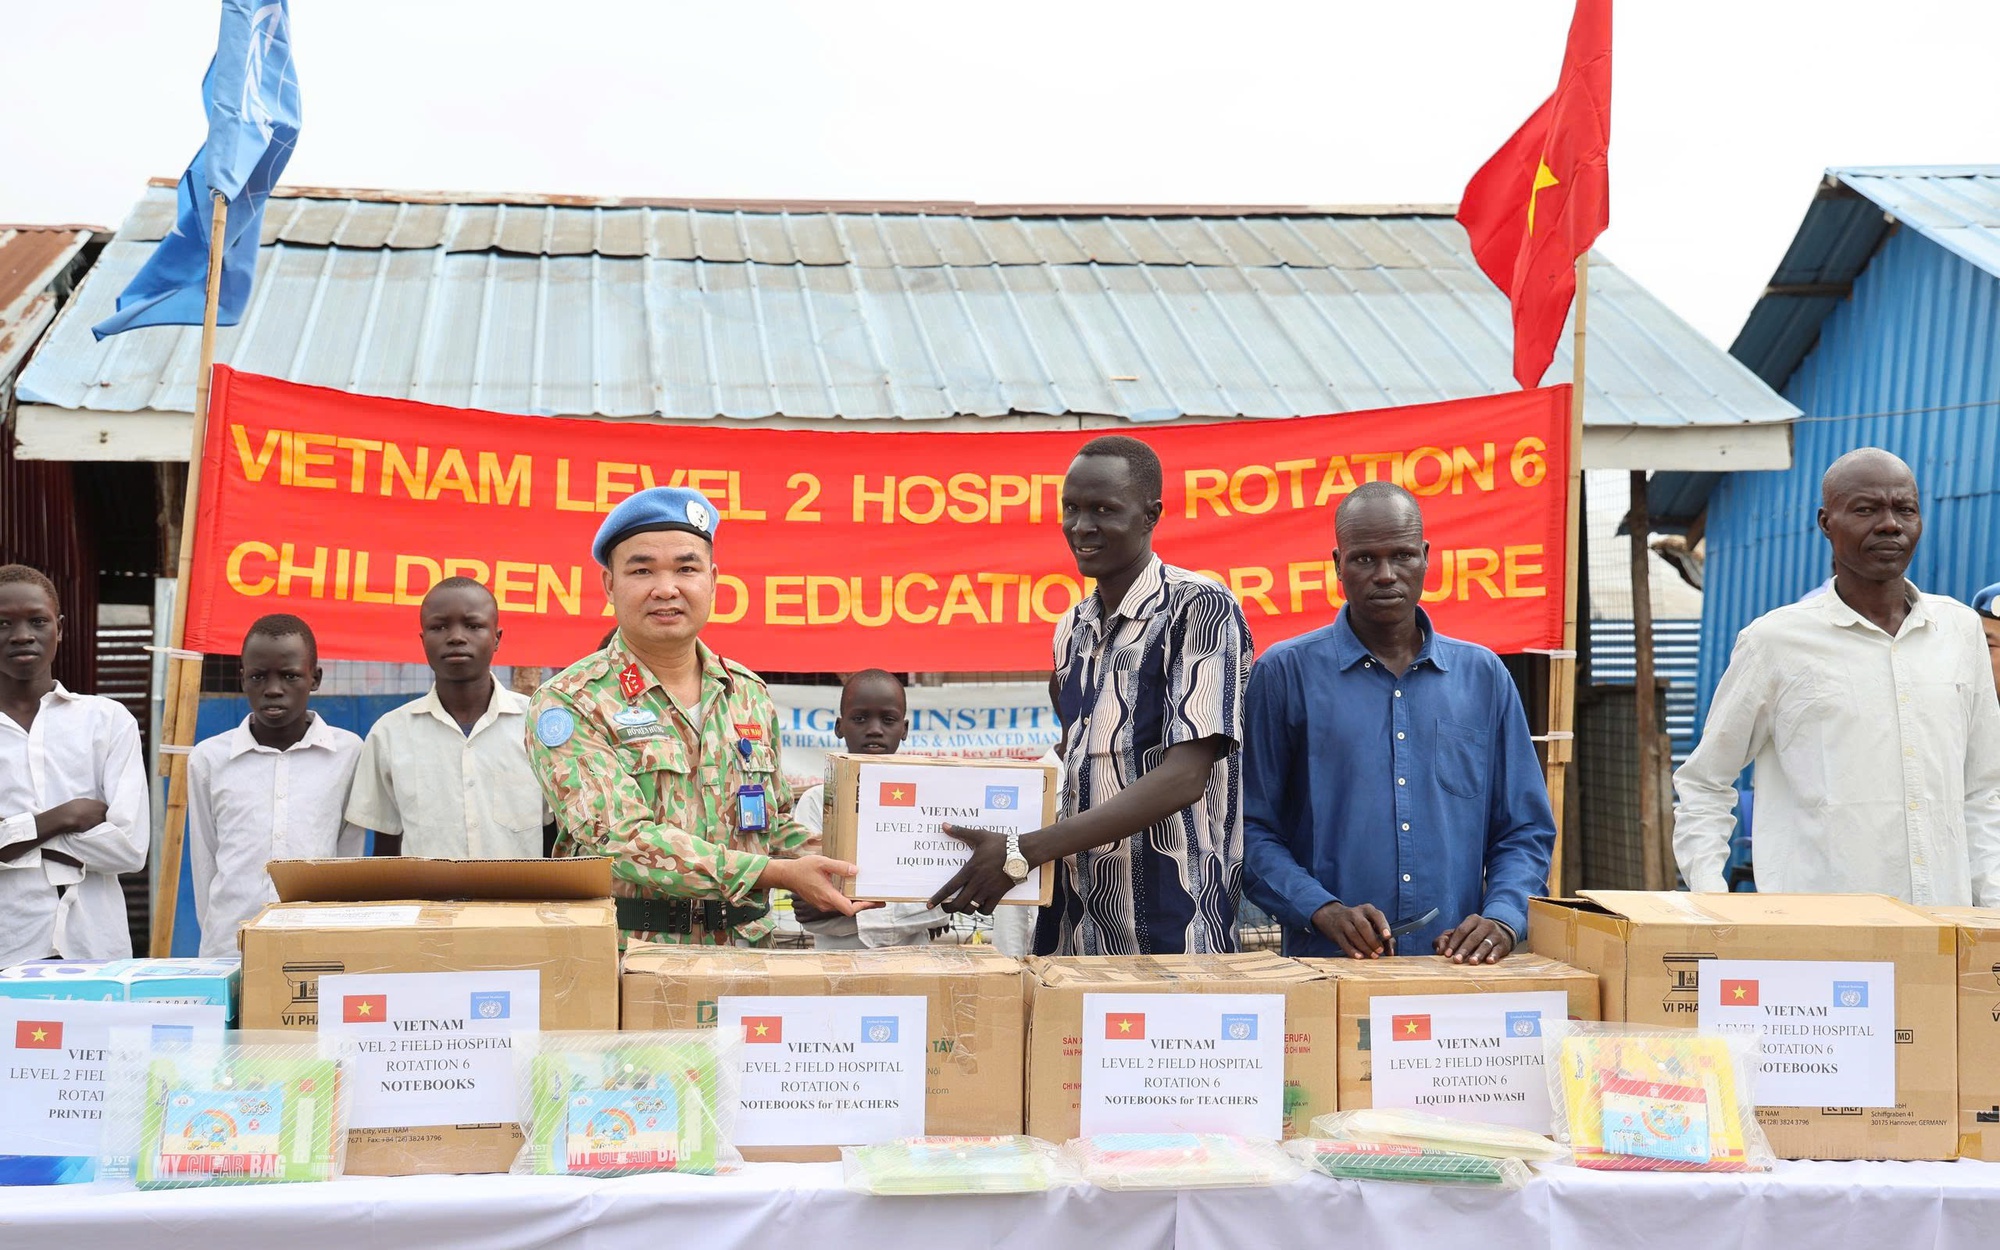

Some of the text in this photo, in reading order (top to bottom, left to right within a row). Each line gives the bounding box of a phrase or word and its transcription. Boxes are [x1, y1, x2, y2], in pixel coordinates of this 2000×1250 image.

[231, 424, 532, 508] VIETNAM
[785, 472, 821, 522] 2
[852, 466, 1066, 526] HOSPI
[1185, 442, 1495, 519] ROTATION
[1510, 436, 1547, 488] 6
[765, 572, 1097, 627] EDUCATIO
[1288, 544, 1547, 614] FURE
[796, 735, 847, 747] HEAL
[949, 733, 1024, 747] ADVANCED
[920, 806, 980, 818] VIETNAM
[875, 822, 914, 833] LEVEL
[917, 823, 923, 833] 2
[926, 823, 964, 834] FIE
[914, 841, 976, 852] ROTATION
[896, 857, 967, 867] LIQUID HAND
[1662, 1003, 1674, 1013] VI
[1765, 1005, 1828, 1017] VIETNAM
[282, 1015, 294, 1025] VI
[393, 1019, 464, 1032] VIETNAM
[1762, 1024, 1768, 1035] 2
[1772, 1024, 1809, 1036] FIELD
[1812, 1024, 1874, 1036] HOSPITAL
[1285, 1033, 1311, 1043] ERUFA)
[1897, 1032, 1910, 1041] MD
[352, 1041, 388, 1053] VEL
[390, 1041, 397, 1052] 2
[401, 1039, 442, 1051] FIELD
[788, 1042, 855, 1053] VIETNAM
[1150, 1038, 1215, 1050] VIETNAM
[1437, 1037, 1500, 1049] VIETNAM
[1761, 1043, 1834, 1055] ROTATION 6
[386, 1058, 470, 1072] ROTATION 6
[784, 1062, 791, 1073] 2
[795, 1061, 835, 1073] FIELD
[838, 1061, 904, 1073] HOSPITAL
[1101, 1058, 1263, 1069] LEVEL 2 FIELD HOSPITAL
[1390, 1057, 1432, 1069] LEVEL
[1435, 1057, 1441, 1069] 2
[1445, 1056, 1482, 1068] FIELD
[10, 1067, 59, 1080] LEVEL
[60, 1069, 71, 1081] 2
[75, 1069, 107, 1081] FIEL
[380, 1078, 475, 1092] NOTEBOOKS
[780, 1081, 860, 1092] ROTATION 6
[1144, 1077, 1220, 1088] ROTATION 6
[1433, 1074, 1507, 1087] ROTATION 6
[58, 1089, 105, 1102] ROTAT
[1104, 1095, 1258, 1105] NOTEBOOKS for TEACHERS
[1415, 1092, 1526, 1105] LIQUID HAND WASH
[740, 1098, 899, 1110] NOTEBOOKS for TEACHERS
[1871, 1110, 1906, 1118] Schiffgraben
[1889, 1119, 1917, 1127] Hannover,
[567, 1144, 593, 1166] MY
[657, 1138, 692, 1161] BAG
[153, 1155, 184, 1179] MY
[186, 1154, 245, 1179] CLEAR
[250, 1154, 286, 1178] BAG
